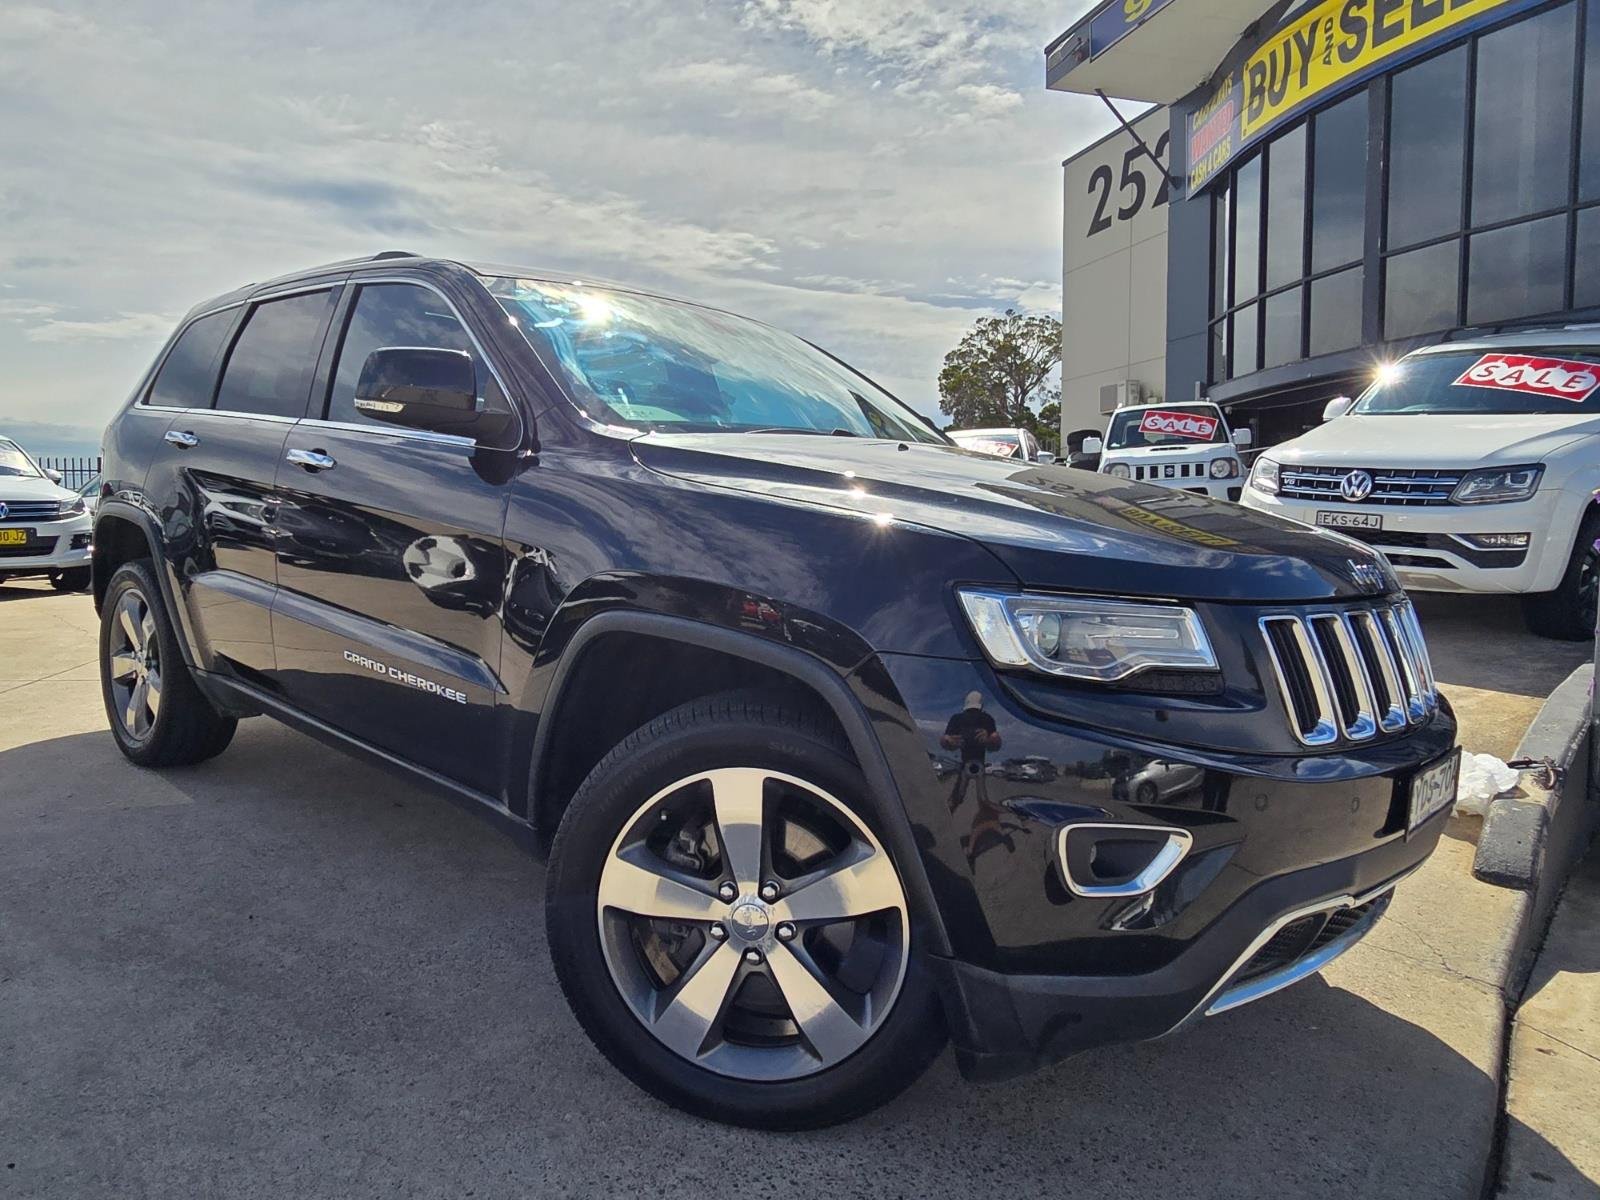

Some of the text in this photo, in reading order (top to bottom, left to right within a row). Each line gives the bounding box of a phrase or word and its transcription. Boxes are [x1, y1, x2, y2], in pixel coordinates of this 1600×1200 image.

[1247, 17, 1320, 124] BUY
[1323, 16, 1334, 65] AND
[1477, 364, 1589, 389] SALE
[1149, 418, 1208, 433] SALE
[343, 650, 467, 705] GRAND CHEROKEE
